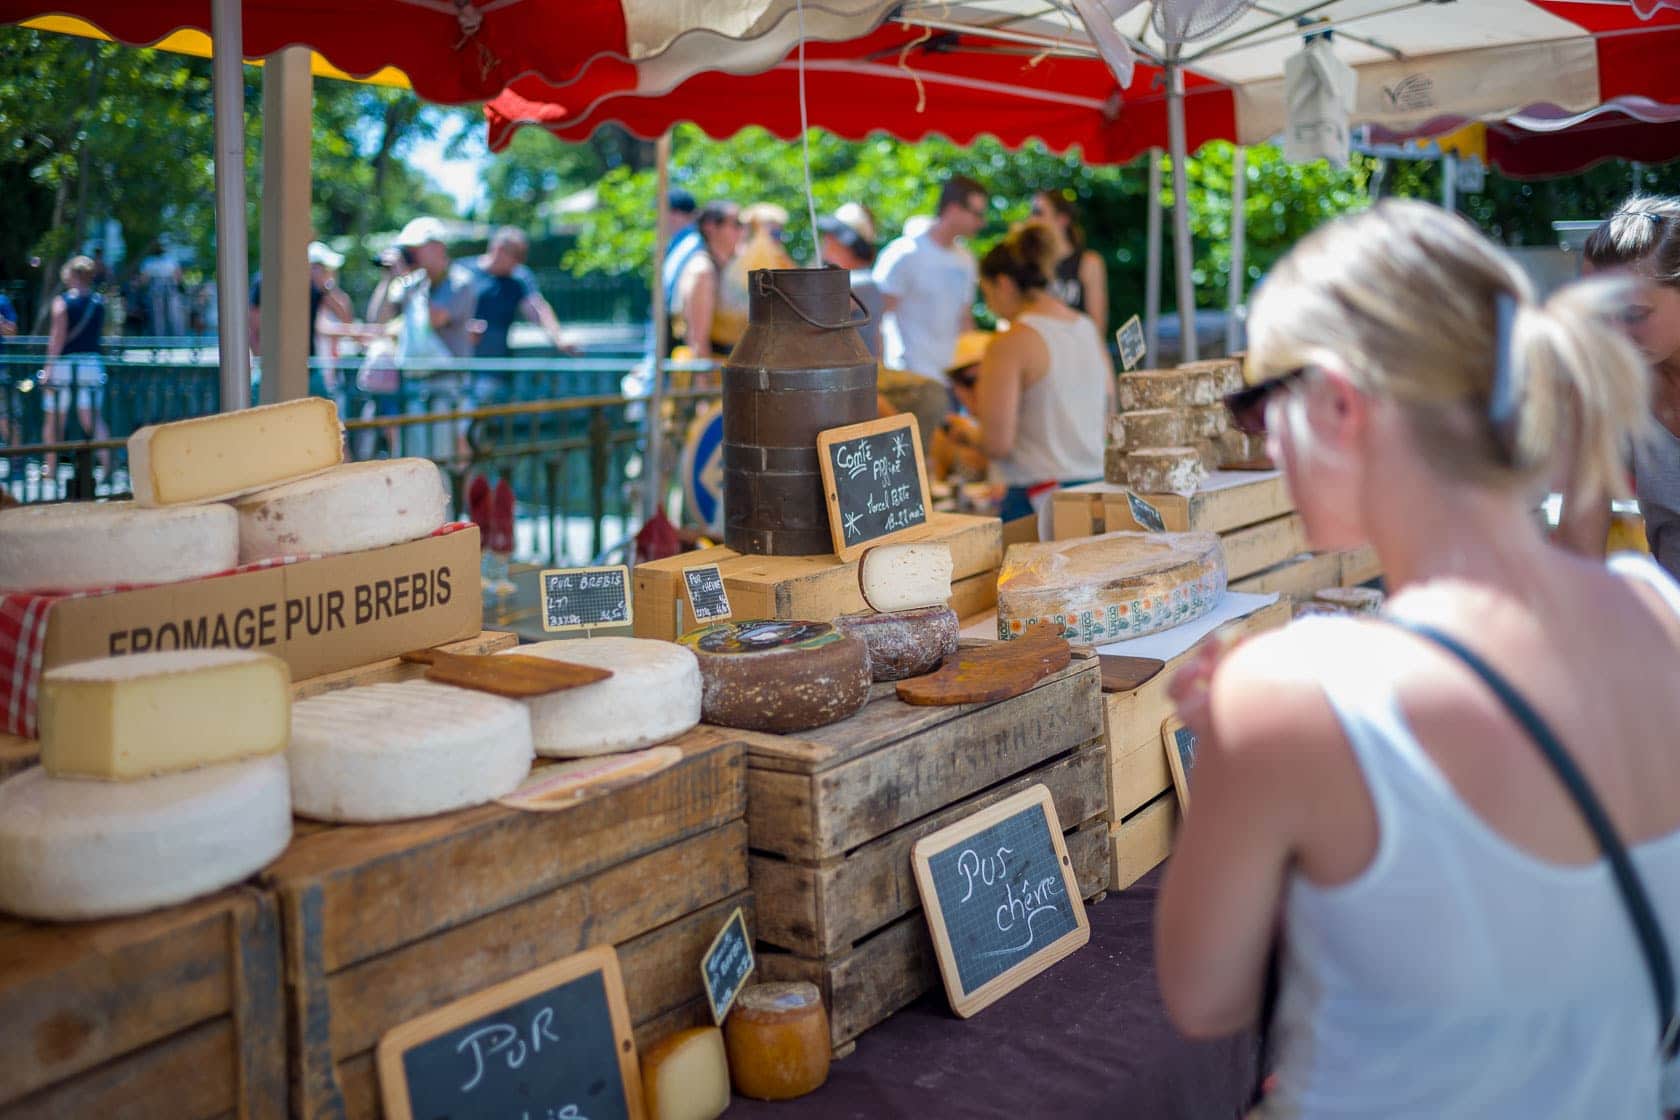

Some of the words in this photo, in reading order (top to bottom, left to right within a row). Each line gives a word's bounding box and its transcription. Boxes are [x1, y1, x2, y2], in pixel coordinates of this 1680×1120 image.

[837, 439, 873, 468] Comté
[580, 575, 621, 589] BREBIS
[109, 604, 277, 658] FROMAGE
[285, 590, 345, 641] PUR
[355, 566, 452, 625] BREBIS
[456, 1006, 560, 1092] PUR
